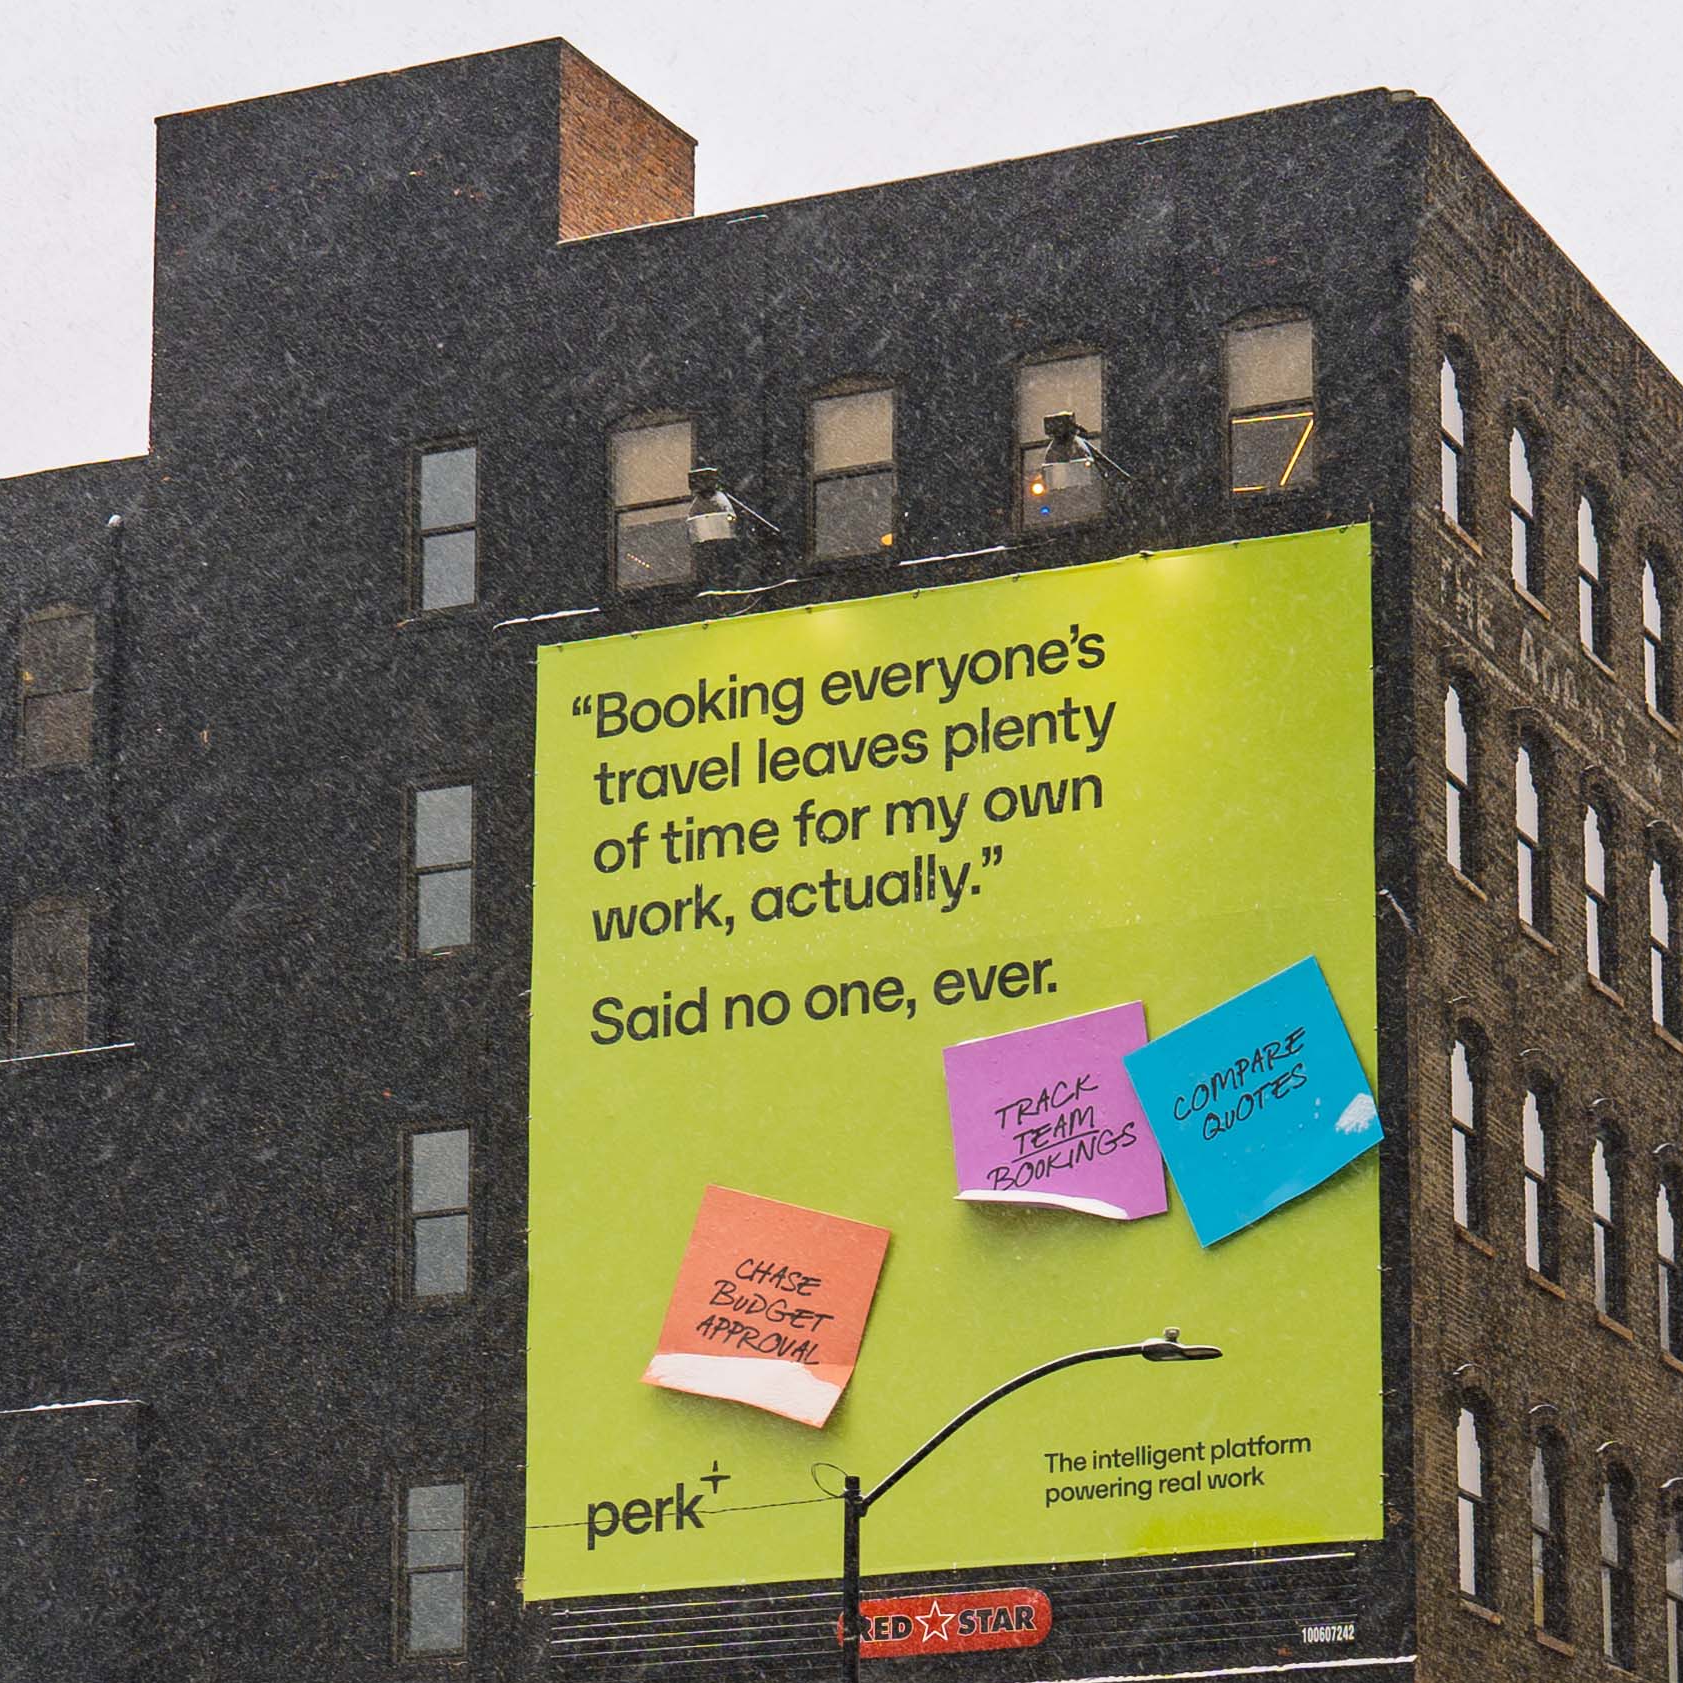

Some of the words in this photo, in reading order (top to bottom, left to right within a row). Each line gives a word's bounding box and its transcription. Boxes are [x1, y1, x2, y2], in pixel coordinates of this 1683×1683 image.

[572, 674, 804, 739] “Booking
[821, 623, 1105, 706] everyone’s
[593, 742, 740, 805] travel
[758, 729, 928, 784] leaves
[945, 697, 1116, 772] plenty
[593, 821, 649, 874] of
[660, 816, 779, 865] time
[793, 799, 871, 847] for
[886, 792, 969, 843] my
[984, 774, 1102, 822] own
[592, 884, 734, 942] work,
[751, 845, 1003, 922] actually.”
[590, 986, 707, 1045] Said
[725, 990, 791, 1030] no
[804, 976, 916, 1021] one,
[933, 958, 1057, 1006] ever.
[995, 1073, 1099, 1130] TRACK
[1174, 1026, 1307, 1121] COMPARE
[1203, 1062, 1307, 1140] QUOTES
[986, 1121, 1138, 1193] BOOKINGS
[1013, 1105, 1097, 1155] TEAM
[709, 1279, 835, 1333] BUDGET
[735, 1258, 822, 1298] CHASE
[695, 1313, 821, 1366] APPROVAL
[1044, 1452, 1087, 1473] The
[1093, 1441, 1205, 1470] intelligent
[1211, 1435, 1311, 1465] platform
[586, 1482, 704, 1551] perk
[1046, 1479, 1152, 1508] powering
[1159, 1470, 1201, 1494] real
[1207, 1466, 1265, 1490] work
[957, 1604, 1038, 1636] STAR
[1302, 1625, 1355, 1643] 100607242
